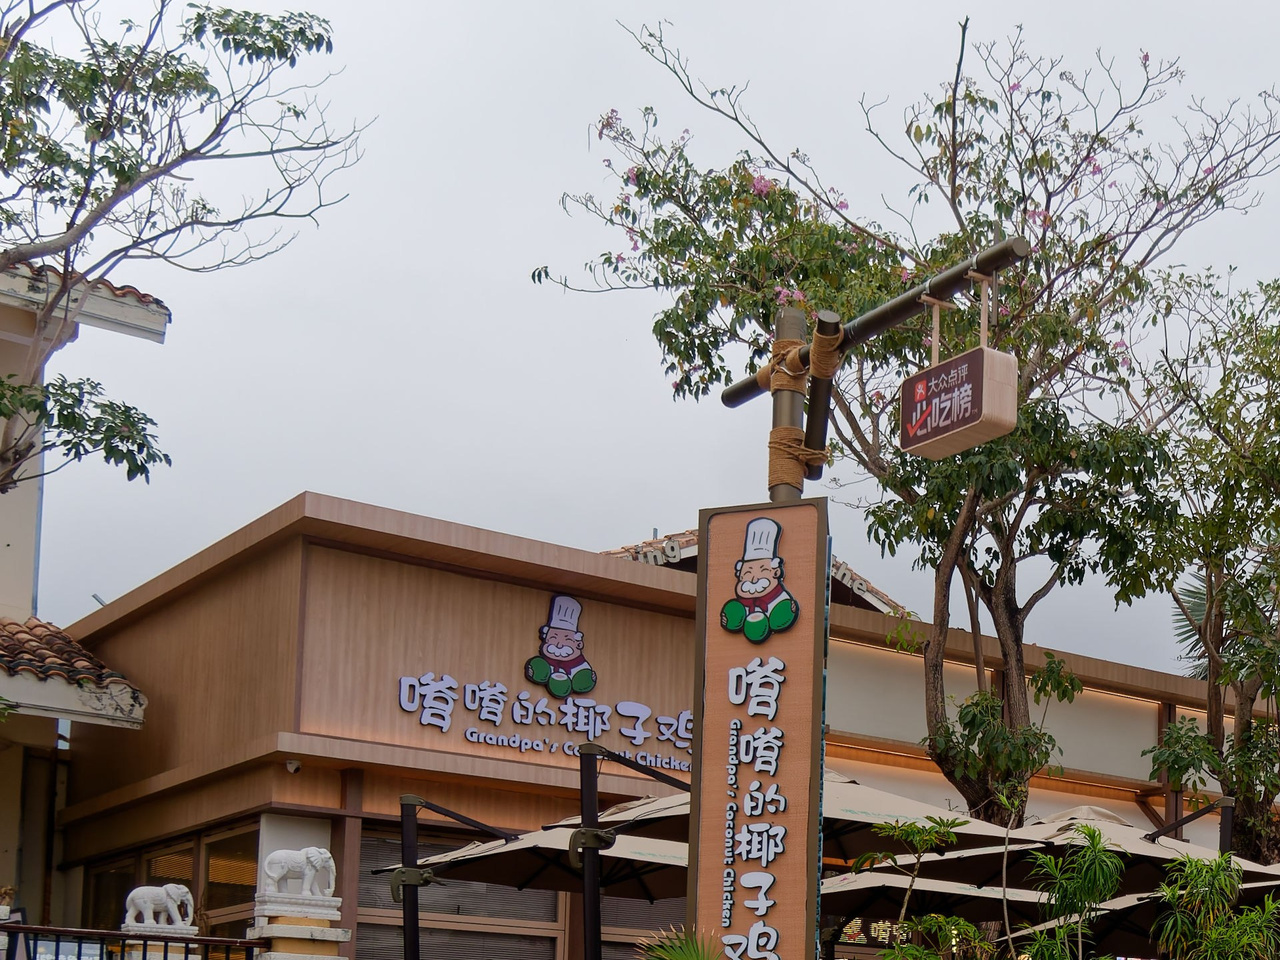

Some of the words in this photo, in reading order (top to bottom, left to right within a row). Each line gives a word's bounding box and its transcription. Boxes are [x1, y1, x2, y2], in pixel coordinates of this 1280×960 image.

[928, 364, 969, 396] 大众点评
[465, 727, 559, 752] Grandpa's
[724, 718, 741, 799] Grandpa's
[723, 801, 738, 864] Coconut
[721, 866, 735, 928] Chicken
